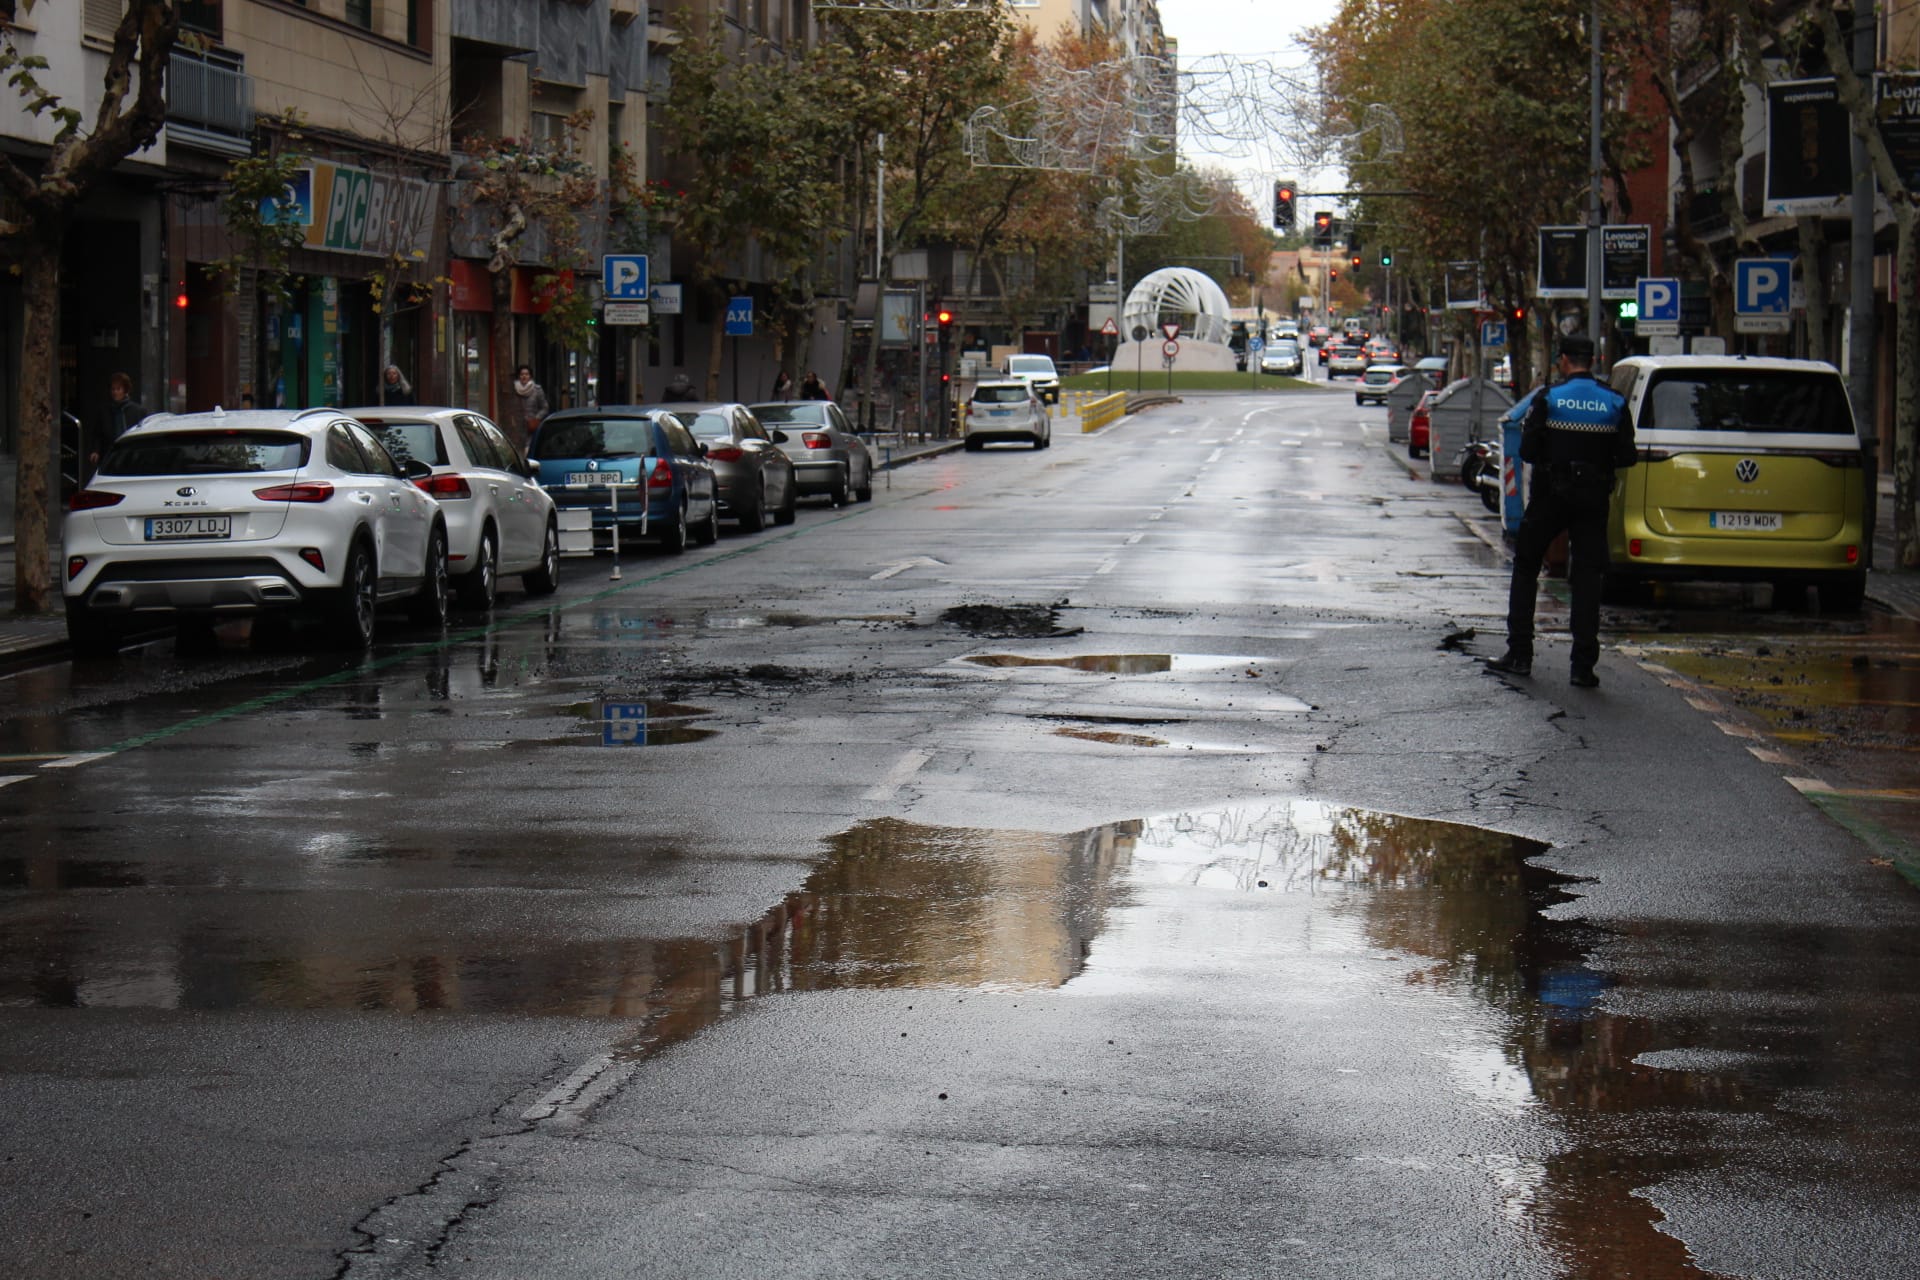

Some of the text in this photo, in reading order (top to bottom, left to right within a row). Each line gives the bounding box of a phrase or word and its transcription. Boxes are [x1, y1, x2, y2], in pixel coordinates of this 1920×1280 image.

[613, 260, 639, 294] P
[1748, 267, 1779, 306] P
[1645, 283, 1671, 317] P
[725, 310, 752, 322] AXI
[571, 473, 594, 483] 5113
[155, 519, 227, 534] 3307 LDJ
[1721, 514, 1776, 526] 1219 MDK
